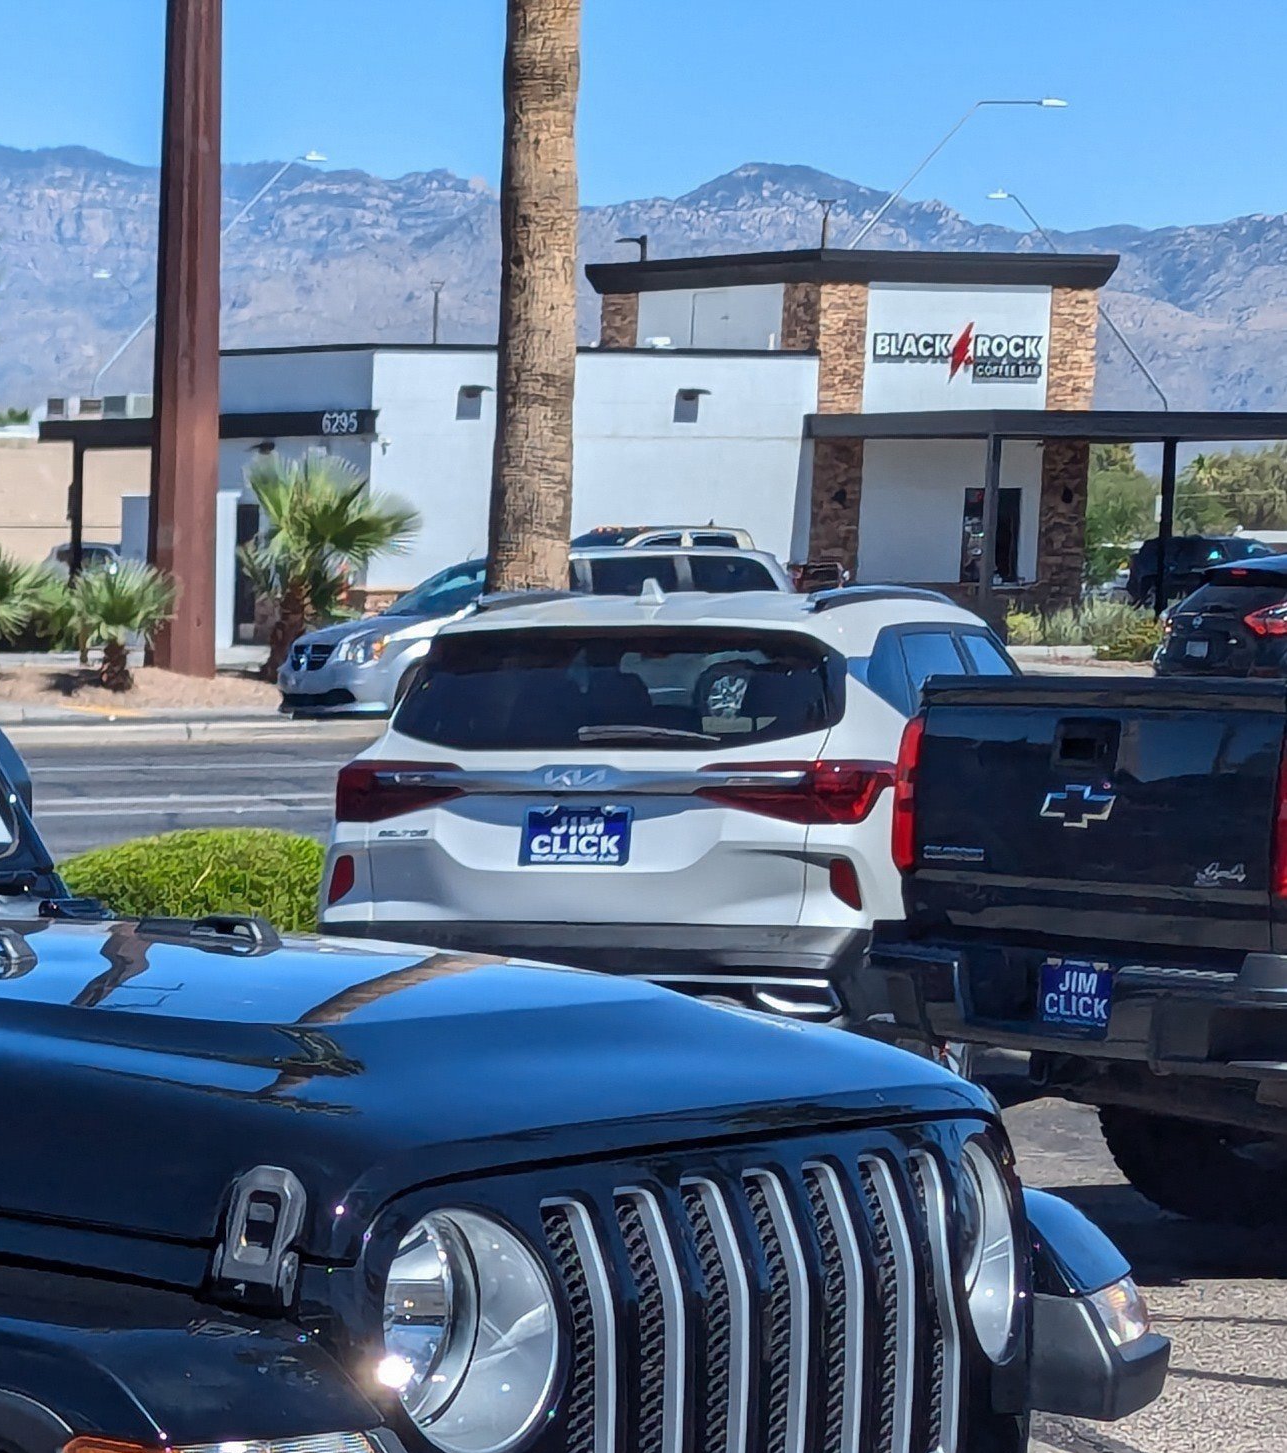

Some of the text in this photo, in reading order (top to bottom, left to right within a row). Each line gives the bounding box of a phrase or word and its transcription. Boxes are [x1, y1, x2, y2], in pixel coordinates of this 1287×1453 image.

[874, 333, 1044, 360] BLACK ROCK
[977, 364, 1041, 378] COFFEE BAR
[322, 412, 358, 434] 6295
[550, 816, 605, 835] JIM
[530, 834, 620, 854] CLICK
[1058, 970, 1098, 995] JIM
[1045, 992, 1109, 1020] CLICK
